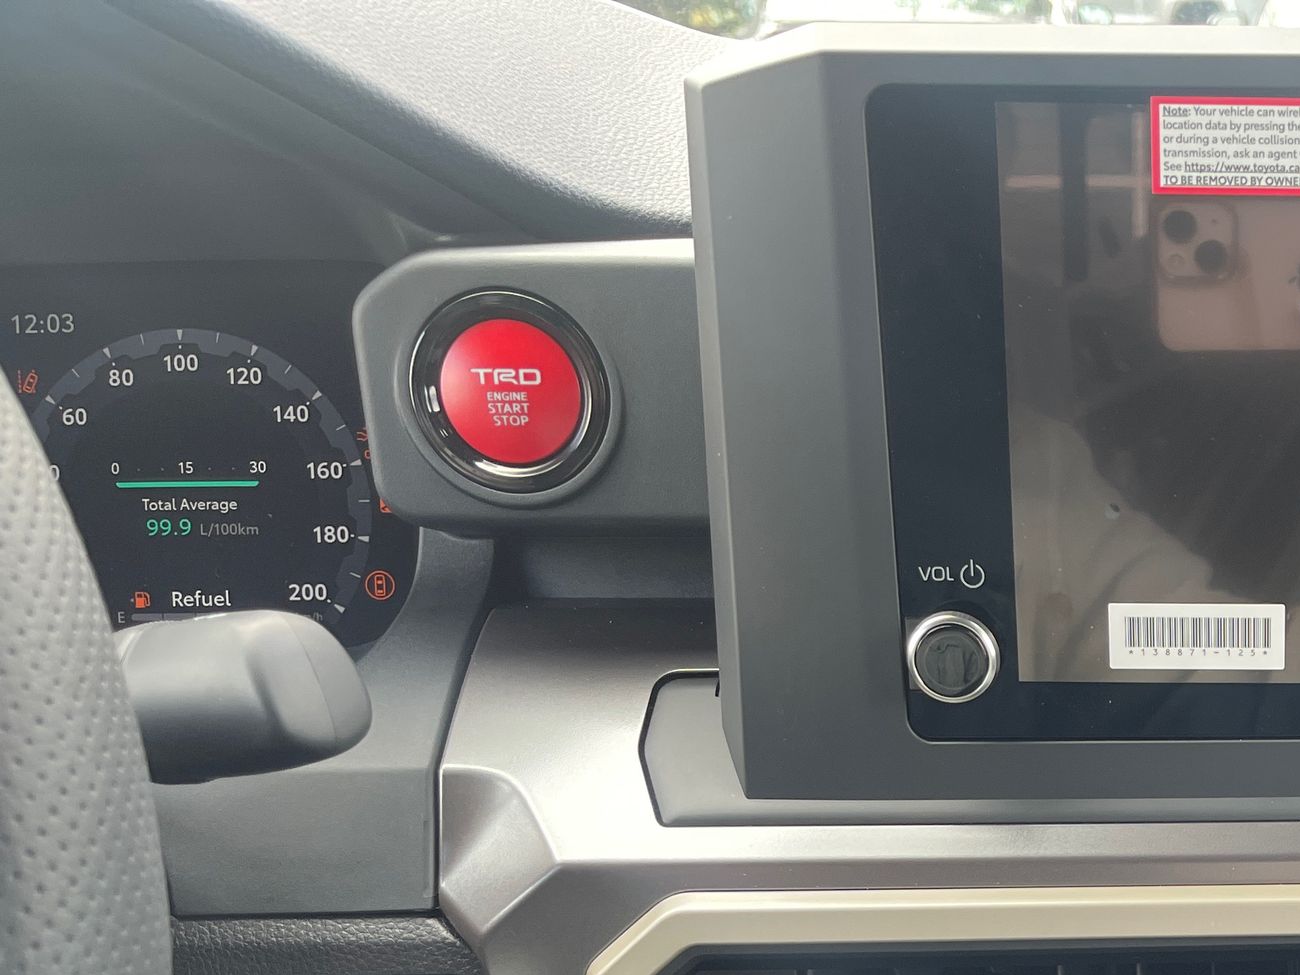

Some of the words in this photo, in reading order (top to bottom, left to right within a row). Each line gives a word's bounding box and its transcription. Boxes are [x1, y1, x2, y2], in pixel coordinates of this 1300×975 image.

[1162, 106, 1191, 117] Note:
[1193, 107, 1216, 116] Your
[1219, 106, 1254, 116] vehicle
[1257, 109, 1275, 117] can
[1163, 119, 1202, 130] location
[1204, 120, 1227, 130] data
[1229, 120, 1241, 132] by
[1243, 121, 1285, 133] pressing
[1163, 136, 1176, 144] or
[1175, 133, 1209, 146] during
[1211, 136, 1218, 144] a
[1220, 134, 1256, 145] vehicle
[1163, 148, 1230, 160] transmission,
[1232, 148, 1250, 159] ask
[1267, 150, 1297, 161] agent
[1163, 161, 1182, 171] See
[1163, 175, 1178, 186] TO
[1180, 175, 1193, 186] BE
[1196, 175, 1248, 186] REMOVED
[1250, 176, 1263, 187] BY
[11, 314, 75, 334] 12:03
[163, 354, 198, 372] 100
[109, 369, 134, 387] 80
[227, 368, 262, 385] 120
[470, 368, 542, 385] TRD
[486, 391, 528, 401] ENGINE
[273, 406, 309, 423] 140
[487, 403, 529, 414] START
[62, 408, 87, 426] 60
[493, 415, 529, 426] STOP
[111, 462, 120, 475] 0
[178, 461, 194, 474] 15
[250, 461, 267, 474] 30
[307, 462, 343, 480] 160
[142, 498, 177, 511] Total
[180, 499, 238, 514] Average
[146, 518, 192, 536] 99.9
[200, 522, 259, 537] L/100km
[313, 526, 349, 543] 180
[918, 566, 954, 582] VOL
[172, 590, 231, 607] Refuel
[289, 584, 327, 601] 200
[118, 611, 125, 624] E
